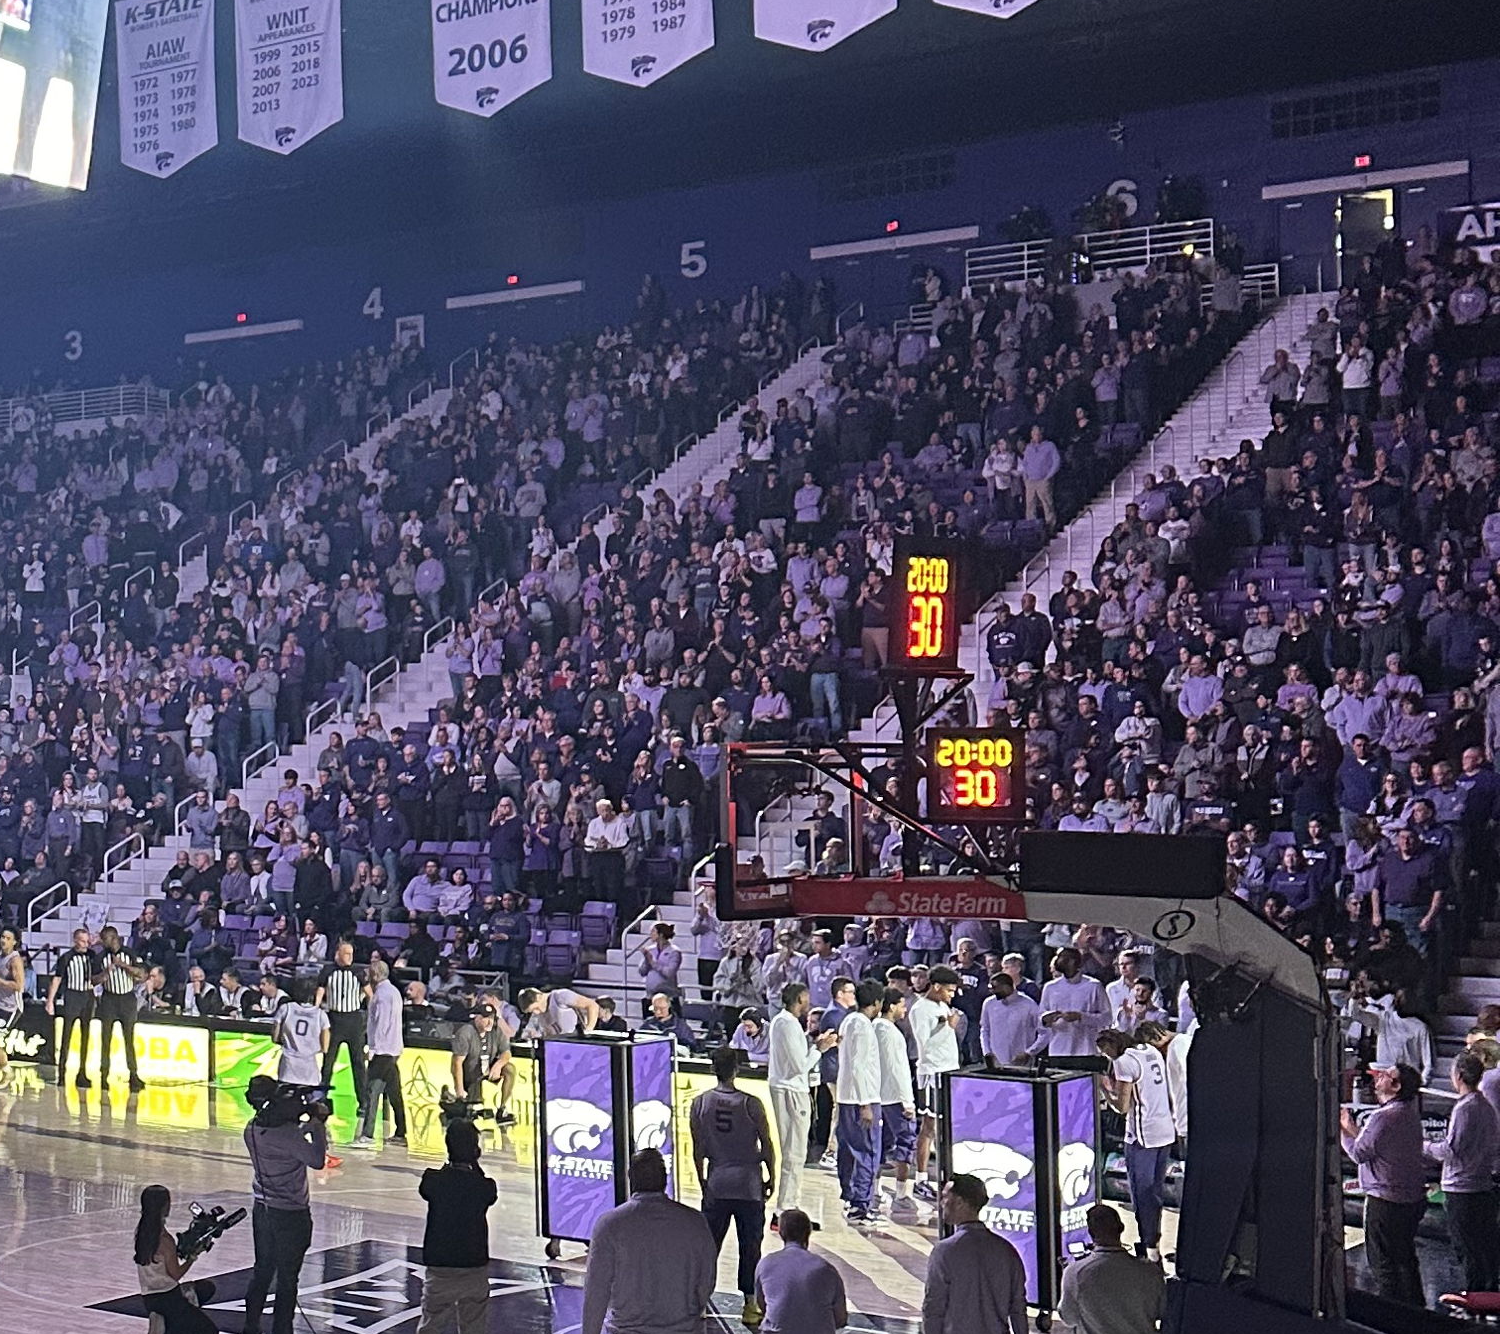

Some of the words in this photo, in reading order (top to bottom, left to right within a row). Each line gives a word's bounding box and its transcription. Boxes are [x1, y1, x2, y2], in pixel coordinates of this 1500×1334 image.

[265, 6, 310, 32] WNIT
[601, 6, 636, 26] 1978
[257, 22, 316, 43] APPEARANCES
[601, 24, 636, 44] 1979
[651, 14, 686, 33] 1987
[145, 36, 186, 61] AIAW
[252, 47, 281, 65] 1999
[291, 39, 320, 57] 2015
[447, 34, 529, 77] 2006
[133, 75, 160, 91] 1972
[170, 68, 197, 84] 1977
[252, 65, 281, 82] 2006
[291, 57, 320, 74] 2018
[133, 91, 160, 107] 1973
[170, 84, 197, 100] 1978
[252, 82, 281, 99] 2007
[291, 74, 320, 91] 2023
[133, 107, 160, 123] 1974
[170, 100, 197, 116] 1979
[252, 98, 281, 115] 2013
[133, 123, 160, 139] 1975
[170, 117, 197, 133] 1980
[132, 138, 160, 154] 1976
[680, 241, 707, 278] 5
[363, 288, 384, 321] 4
[65, 330, 83, 361] 3
[907, 556, 948, 594] 20:00
[907, 595, 943, 658] 30
[936, 737, 1013, 768] 20:00
[955, 769, 997, 807] 30
[295, 1019, 309, 1037] 0
[1150, 1063, 1163, 1085] 3
[715, 1109, 733, 1133] 5
[548, 1154, 613, 1175] K-STATE
